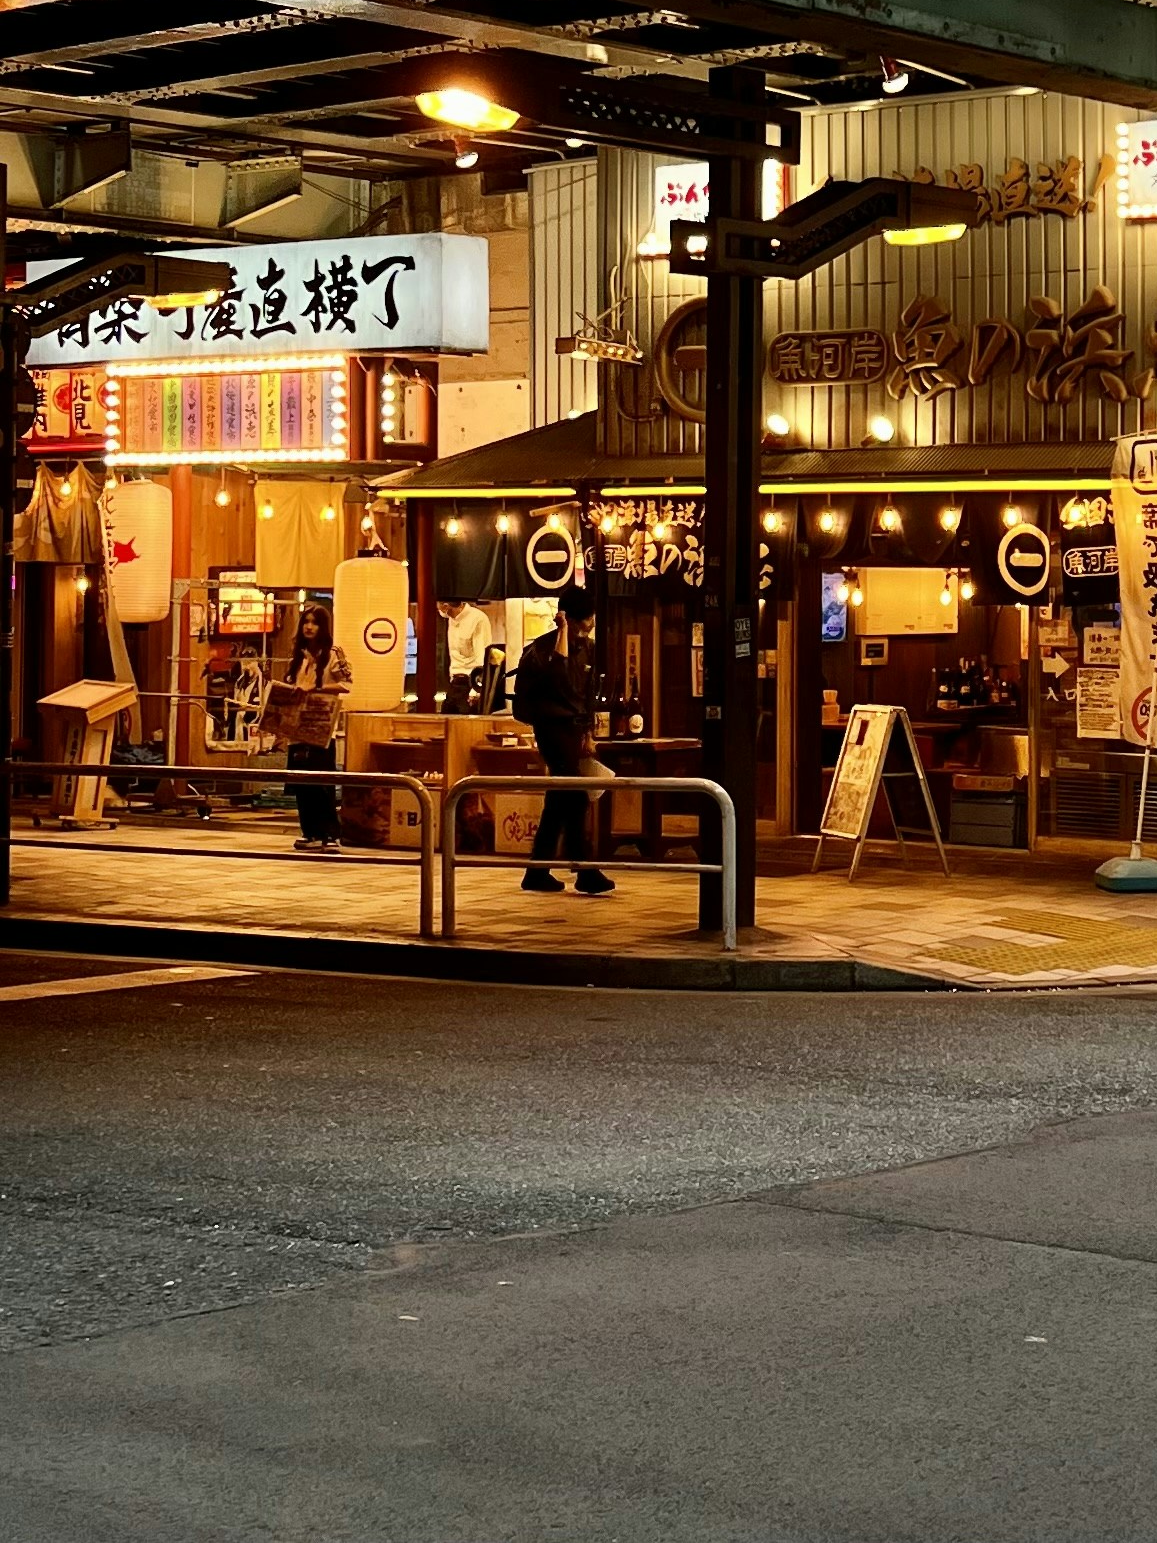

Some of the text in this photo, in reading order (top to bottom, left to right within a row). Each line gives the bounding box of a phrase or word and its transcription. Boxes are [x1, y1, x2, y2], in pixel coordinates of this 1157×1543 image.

[774, 334, 885, 382] 魚河岸
[74, 378, 92, 430] 北見
[1046, 686, 1077, 702] 入口
